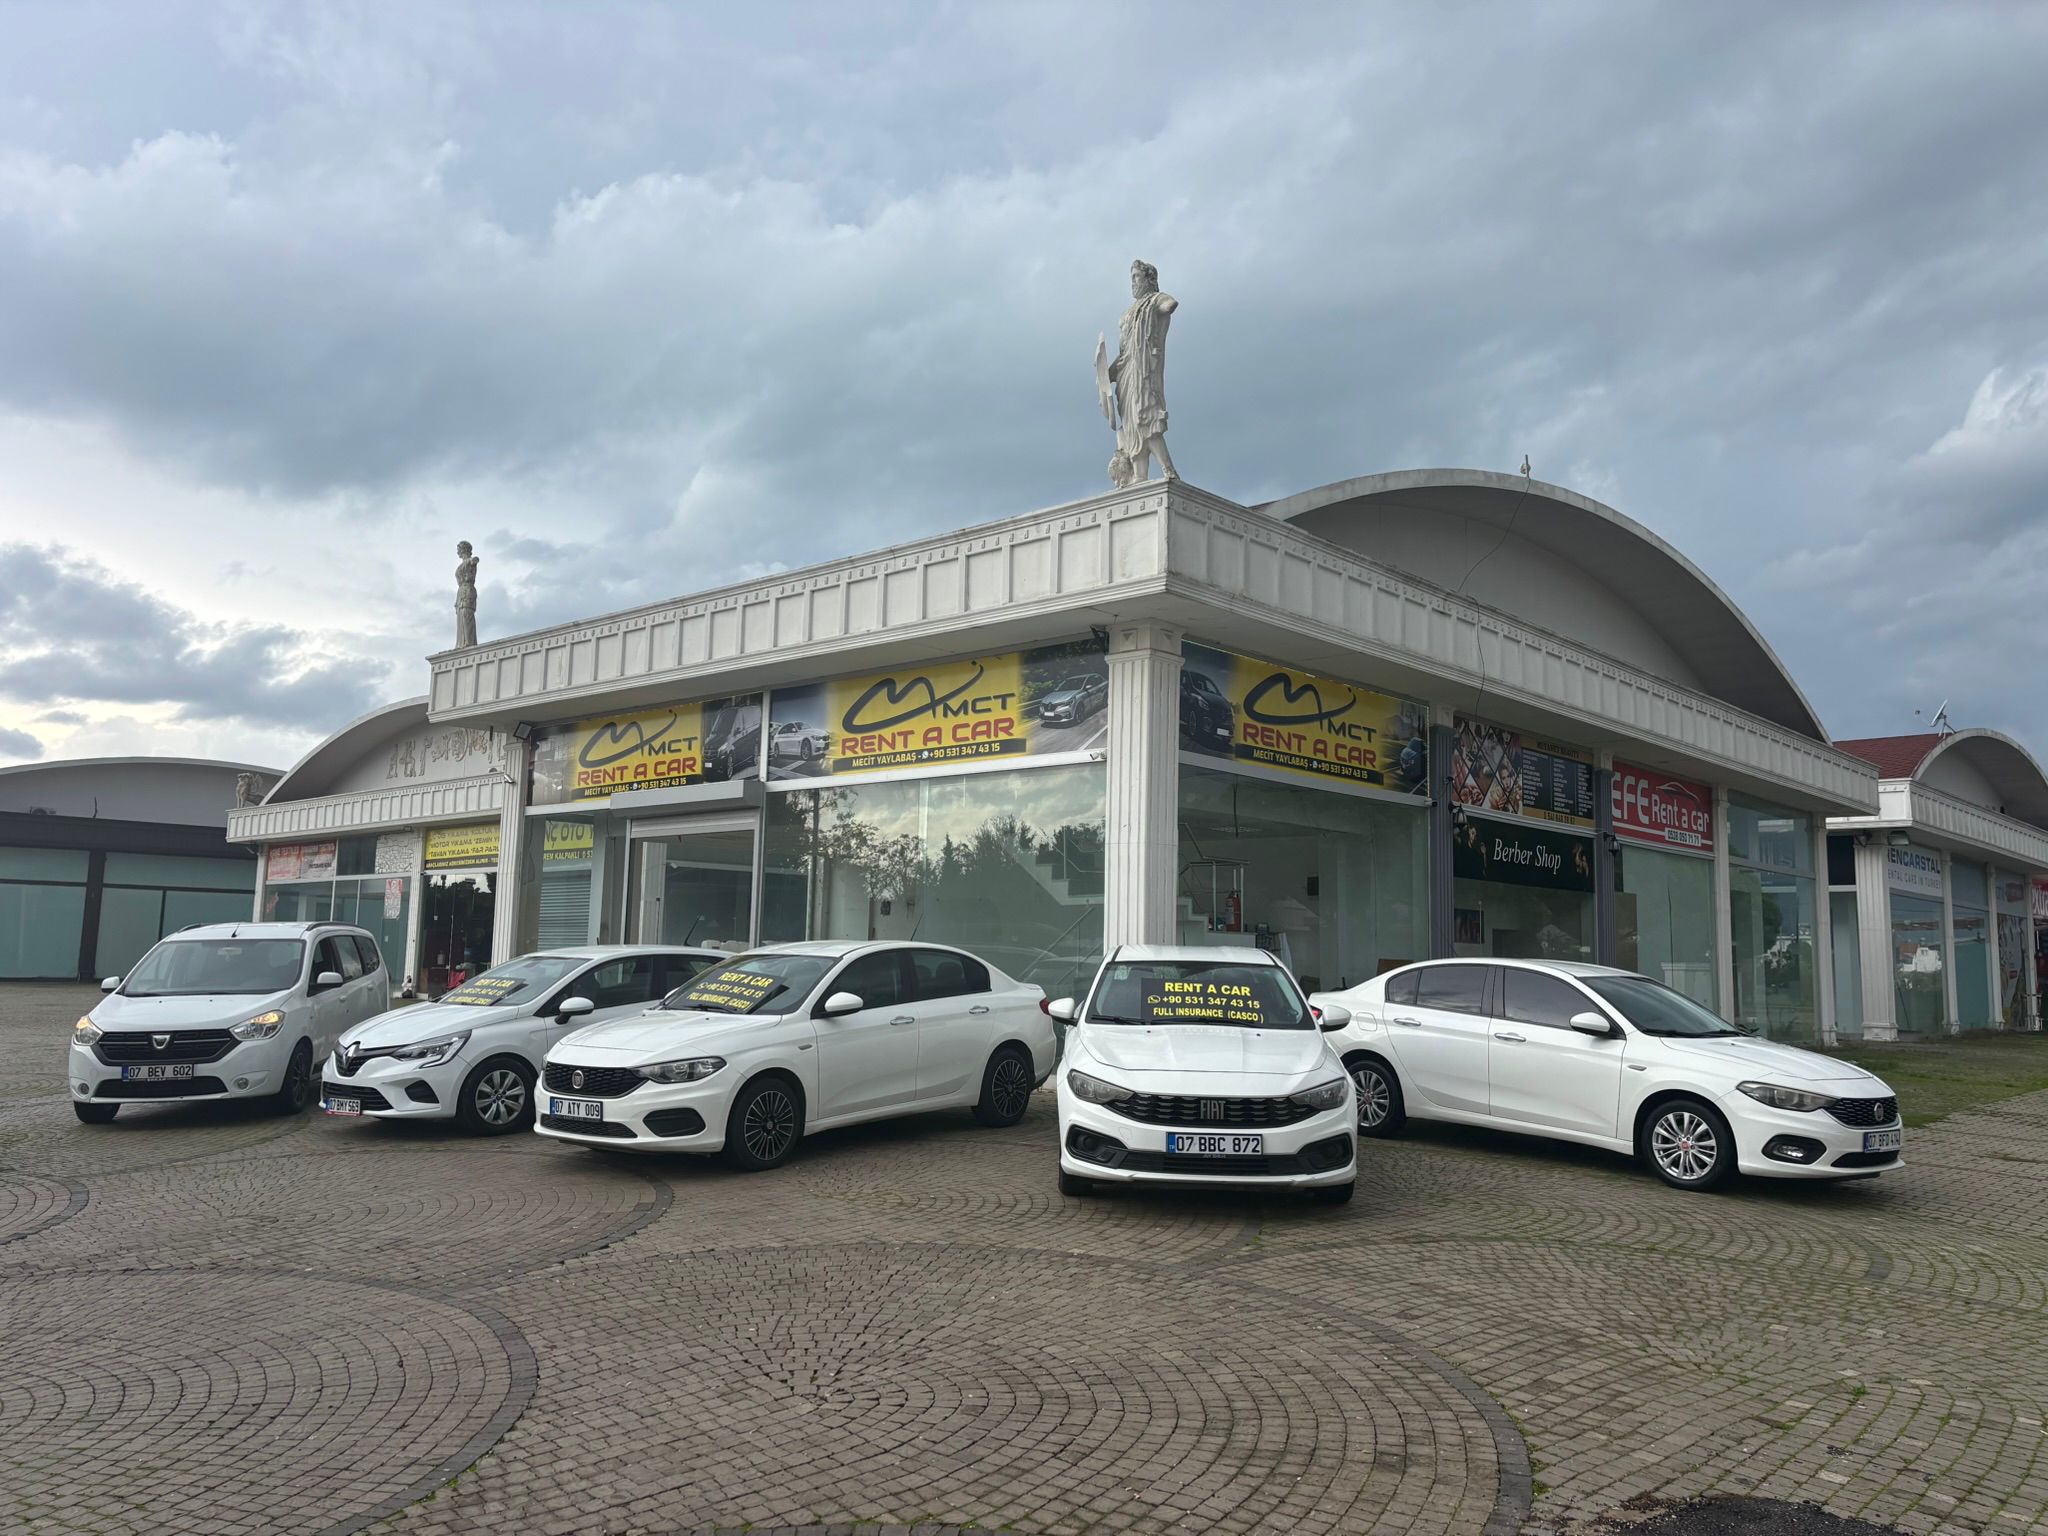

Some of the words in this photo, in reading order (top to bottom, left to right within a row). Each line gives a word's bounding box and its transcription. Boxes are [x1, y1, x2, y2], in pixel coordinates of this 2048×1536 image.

[943, 693, 1016, 718] MCT
[841, 729, 915, 756] RENT
[922, 726, 942, 746] A
[951, 717, 1015, 743] CAR
[1327, 718, 1377, 743] MCT
[648, 736, 698, 757] MCT
[1243, 722, 1307, 753] RENT
[1313, 738, 1328, 759] A
[1334, 742, 1377, 768] CAR
[852, 757, 876, 768] MECİT
[876, 753, 917, 765] YAYLABAŞ
[929, 750, 944, 759] +90
[946, 748, 960, 758] 531
[961, 745, 976, 755] 347
[978, 744, 989, 753] 43
[991, 743, 1000, 752] 15
[1253, 749, 1274, 761] MECİT
[1274, 753, 1309, 770] YAYLABAŞ
[1330, 764, 1340, 774] 531
[1341, 766, 1352, 776] 347
[1353, 768, 1361, 778] 43
[1362, 770, 1368, 779] 15
[578, 765, 629, 786] RENT
[633, 763, 648, 779] A
[654, 756, 697, 777] CAR
[584, 786, 601, 797] MECİT
[650, 780, 660, 789] 531
[660, 779, 671, 788] 347
[671, 778, 680, 787] 43
[680, 777, 687, 785] 15
[1611, 771, 1649, 825] EFE
[1651, 793, 1679, 826] Rent
[1681, 808, 1689, 829] a
[1691, 810, 1710, 833] car
[561, 823, 585, 842] OTO
[1493, 838, 1533, 865] Berber
[1535, 845, 1561, 875] Shop
[718, 971, 747, 983] RENT
[750, 976, 774, 988] CAR
[1164, 982, 1203, 993] RENT
[1207, 984, 1218, 994] A
[1221, 985, 1251, 996] CAR
[716, 984, 731, 993] 531
[729, 986, 743, 995] 347
[743, 988, 753, 997] 43
[753, 990, 765, 999] 15
[1162, 995, 1182, 1004] +90
[1185, 996, 1204, 1005] 531
[1207, 997, 1227, 1006] 347
[1230, 998, 1244, 1007] 43
[1247, 1000, 1260, 1009] 15
[1153, 1007, 1174, 1017] FULL
[1175, 1007, 1224, 1018] INSURANCE
[129, 1067, 141, 1078] 07
[148, 1066, 166, 1078] BEV
[172, 1065, 192, 1076] 602
[337, 1099, 348, 1111] BMY
[555, 1100, 564, 1113] 07
[568, 1102, 581, 1116] ATY
[585, 1103, 600, 1117] 009
[1200, 1099, 1227, 1120] FIAT
[1176, 1136, 1194, 1152] 07
[1198, 1136, 1226, 1152] BBC
[1232, 1137, 1260, 1153] 872
[1869, 1134, 1876, 1149] 07
